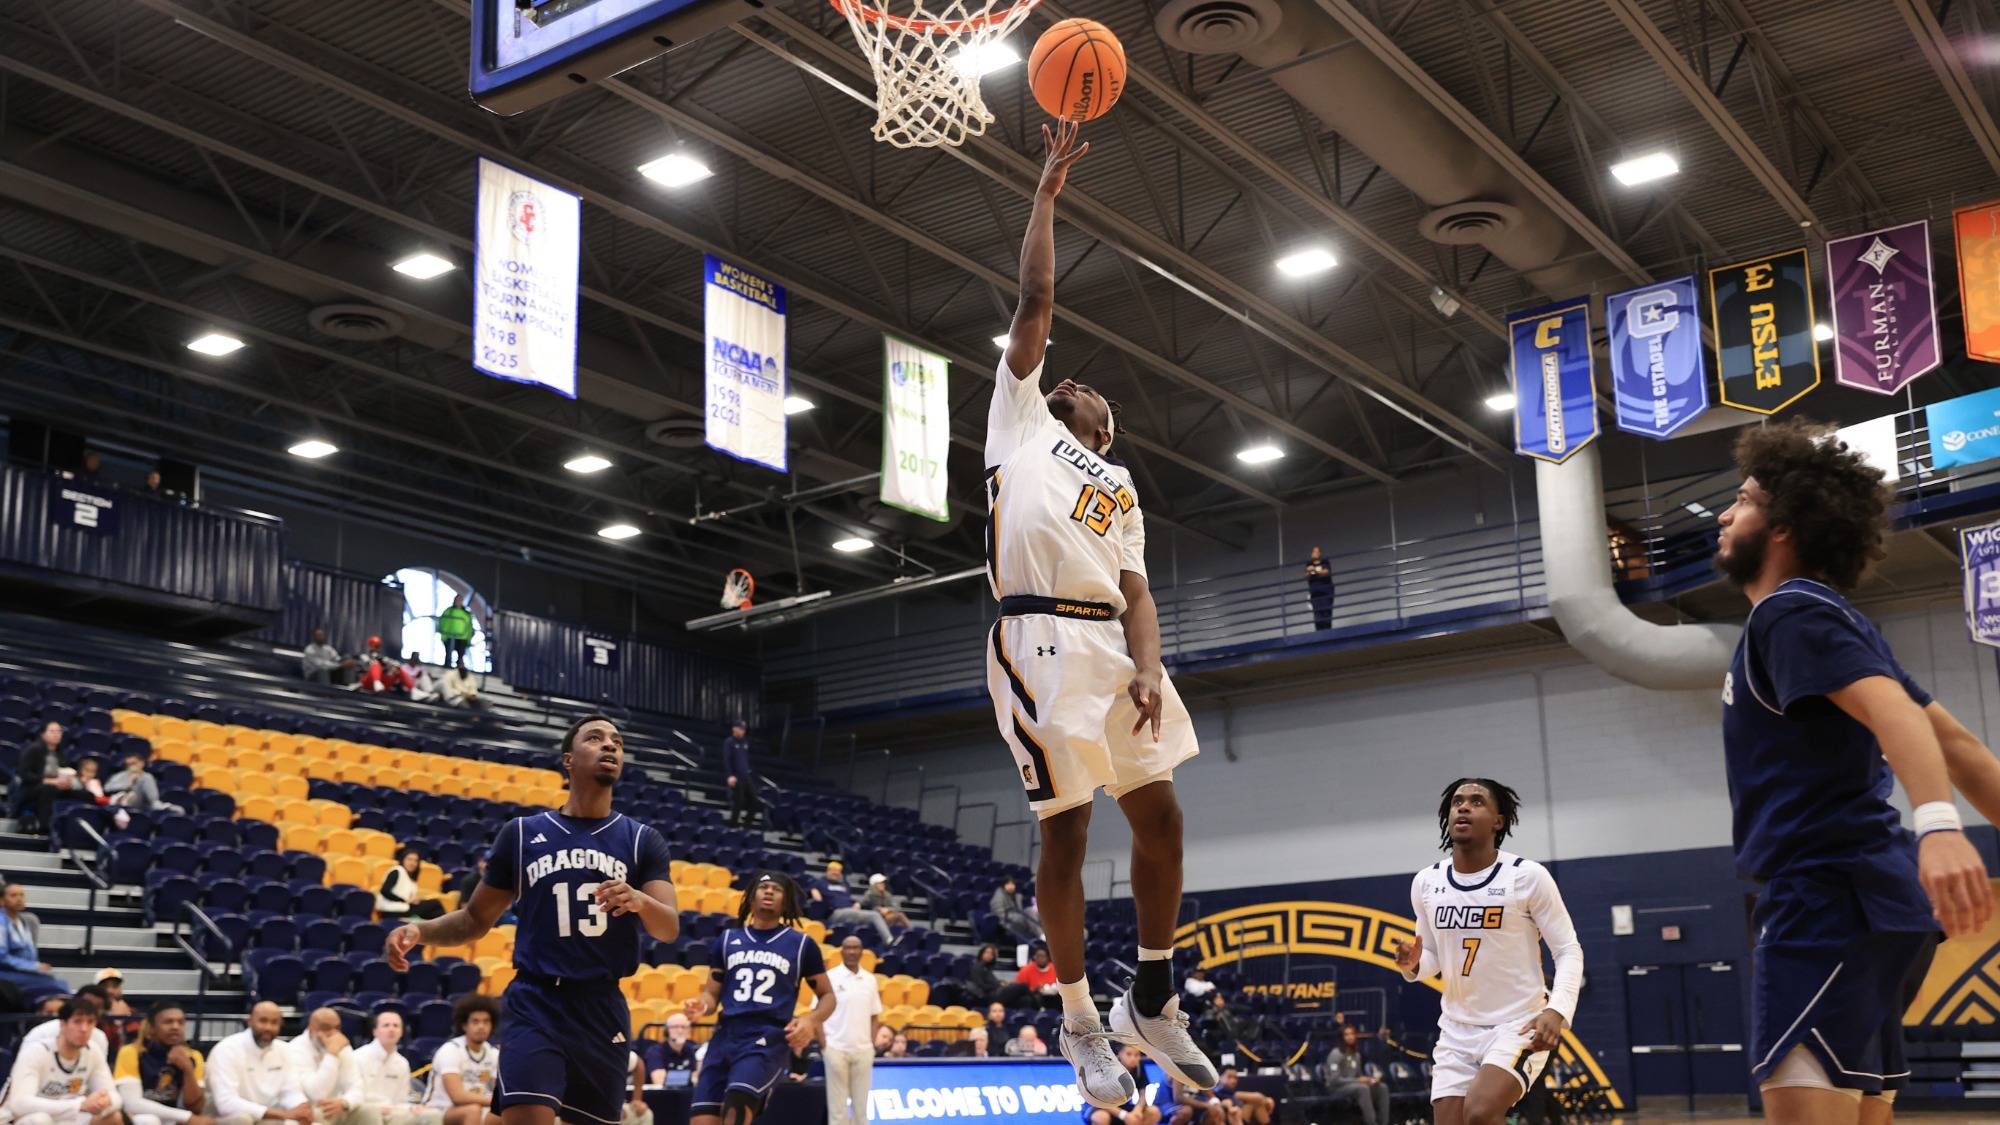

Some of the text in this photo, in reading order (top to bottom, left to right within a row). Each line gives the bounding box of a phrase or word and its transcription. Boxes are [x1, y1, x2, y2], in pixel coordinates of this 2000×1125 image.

[714, 272, 777, 309] BASKETBALL
[721, 262, 773, 296] WOMEN'S
[483, 282, 570, 324] TOURNAMENT
[488, 303, 564, 340] CHAMPIONS
[1627, 289, 1680, 339] C
[485, 323, 518, 346] 1998
[1534, 316, 1563, 349] C
[1869, 283, 1893, 382] FURMAN
[1887, 284, 1901, 369] PALADINS
[483, 345, 518, 369] 2025
[713, 336, 762, 372] NCAA
[1750, 302, 1782, 390] ETSU
[713, 359, 779, 396] TOURNAMENT
[714, 384, 740, 408] 1998
[1648, 335, 1670, 429] THE CITADEL
[1545, 356, 1562, 450] CHATTANOOGA
[899, 450, 938, 479] 2017
[1051, 440, 1134, 515] UNCG
[62, 488, 113, 509] SECTION
[74, 502, 99, 528] 2
[1069, 484, 1118, 537] 13
[593, 647, 609, 666] 3
[526, 848, 628, 888] DRAGONS
[552, 882, 608, 938] 13
[1435, 906, 1505, 930] UNCG
[727, 950, 790, 975] DRAGONS
[1462, 938, 1481, 977] 7
[733, 967, 776, 1005] 32
[982, 1086, 1020, 1115] TO
